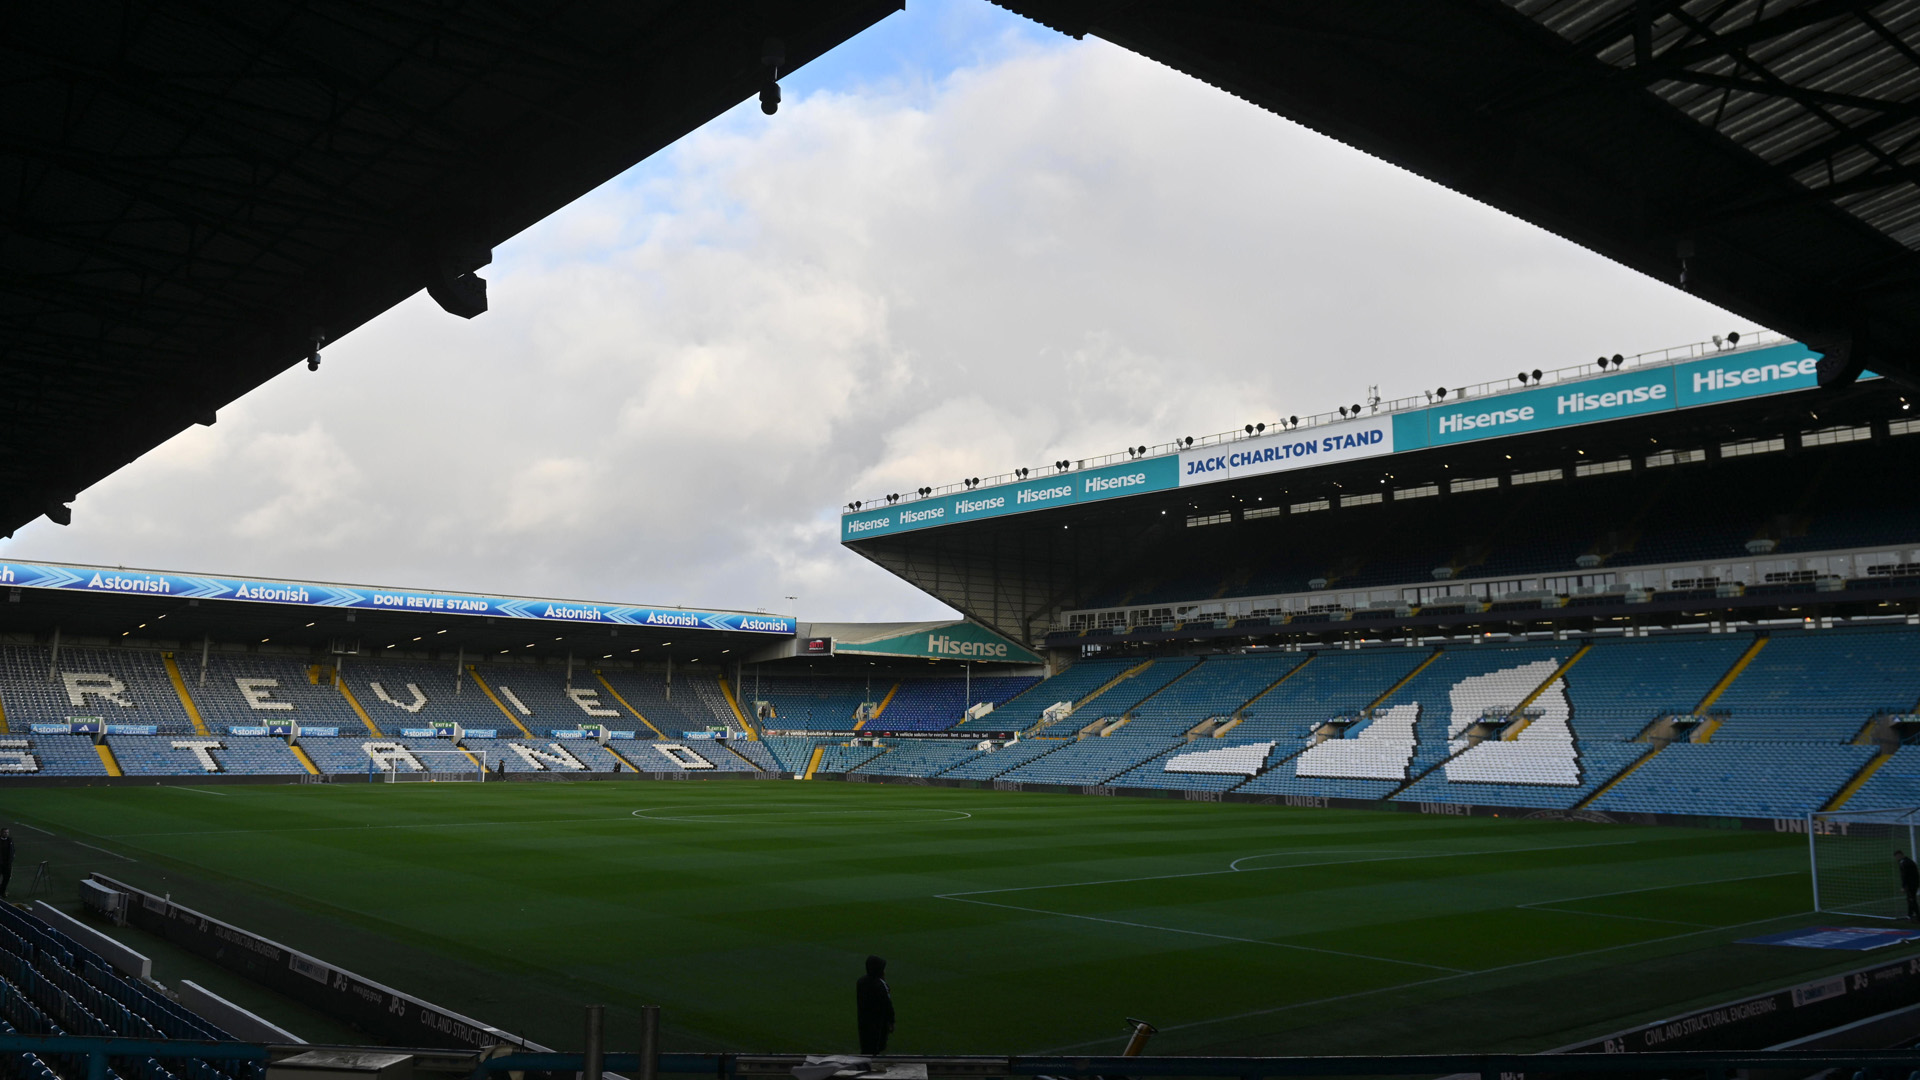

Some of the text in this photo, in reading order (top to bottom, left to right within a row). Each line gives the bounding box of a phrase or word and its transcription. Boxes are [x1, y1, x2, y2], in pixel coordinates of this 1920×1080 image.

[1693, 357, 1818, 393] Hisense
[1557, 384, 1667, 415] Hisense
[1439, 406, 1535, 434] Hisense
[1187, 429, 1384, 475] JACK CHARLTON STAND
[1085, 473, 1146, 493] Hisense
[1017, 485, 1072, 504] Hisense
[955, 496, 1005, 514] Hisense
[900, 507, 945, 524] Hisense
[848, 517, 890, 533] Hisense
[88, 572, 170, 593] Astonish
[235, 583, 309, 602] Astonish
[373, 594, 489, 611] DON REVIE STAND
[544, 604, 601, 620] Astonish
[647, 611, 699, 626] Astonish
[740, 617, 788, 632] Astonish
[927, 634, 1008, 657] Hisense
[32, 726, 68, 734] Astonish
[231, 728, 266, 736] Astonish
[403, 730, 434, 738] Astonish
[555, 730, 582, 738] Astonish
[687, 732, 711, 740] Astonish
[422, 773, 465, 782] UNIBET
[846, 773, 870, 783] UNIBET
[994, 780, 1024, 792] UNIBET
[1082, 785, 1117, 796] UNIBET
[1185, 790, 1224, 802] UNIBET
[1285, 795, 1330, 808] UNIBET
[1420, 802, 1473, 816] UNIBET
[1774, 818, 1850, 836] UNIBET
[333, 972, 348, 992] JPG
[389, 995, 406, 1017] JPG
[421, 1009, 437, 1029] CIVIL
[437, 1016, 451, 1034] AND
[452, 1021, 498, 1048] STRUCTURAL
[1644, 997, 1777, 1047] CIVIL AND STRUCTURAL ENGINEERING
